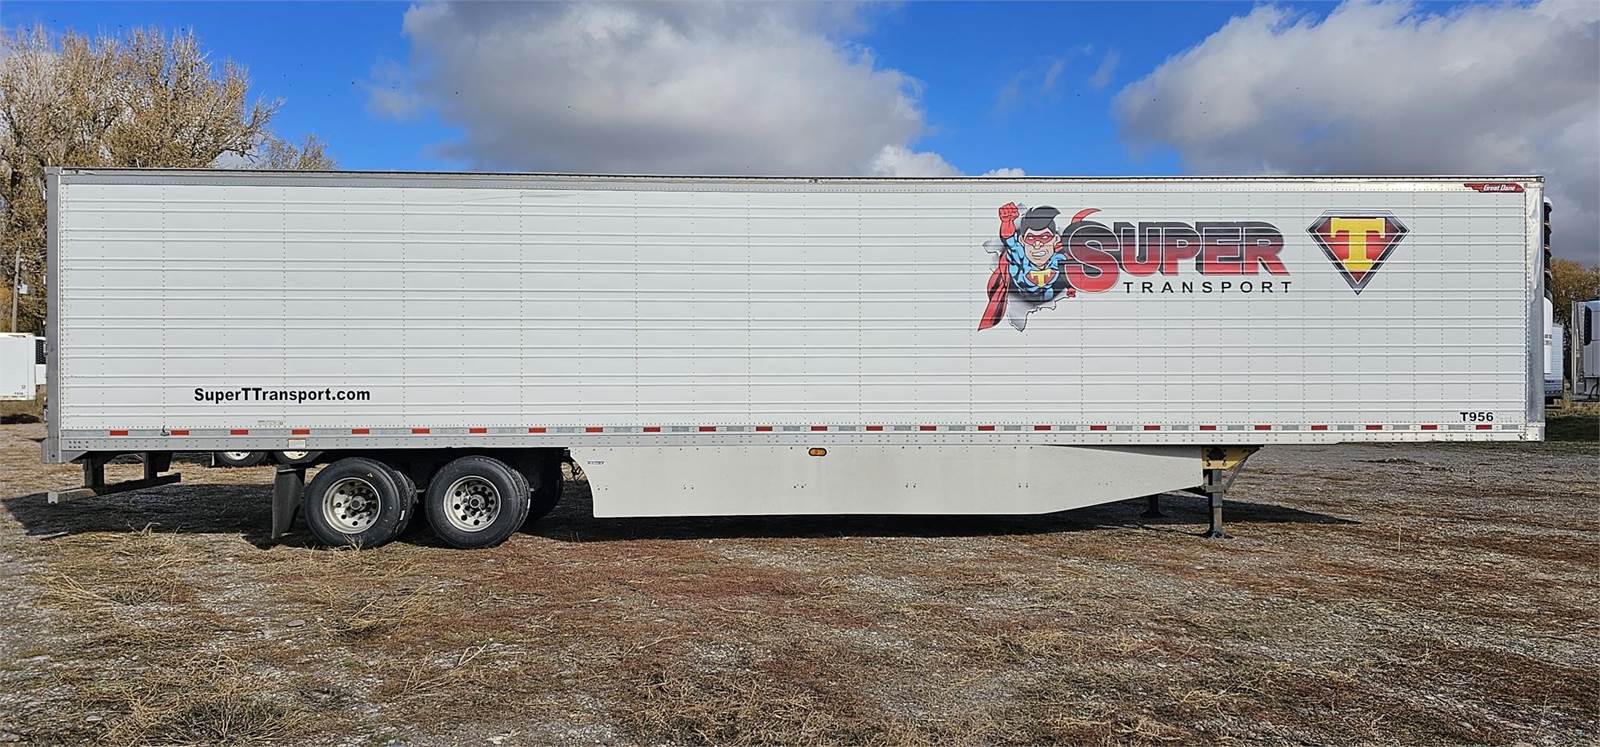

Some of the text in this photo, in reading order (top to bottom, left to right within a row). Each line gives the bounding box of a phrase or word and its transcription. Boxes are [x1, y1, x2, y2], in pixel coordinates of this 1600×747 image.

[1330, 217, 1386, 272] T
[1062, 220, 1291, 293] SUPER
[1029, 269, 1054, 287] T
[1123, 281, 1292, 294] TRANSPORT
[194, 387, 371, 404] SuperTTransport.com
[1460, 411, 1494, 422] T956
